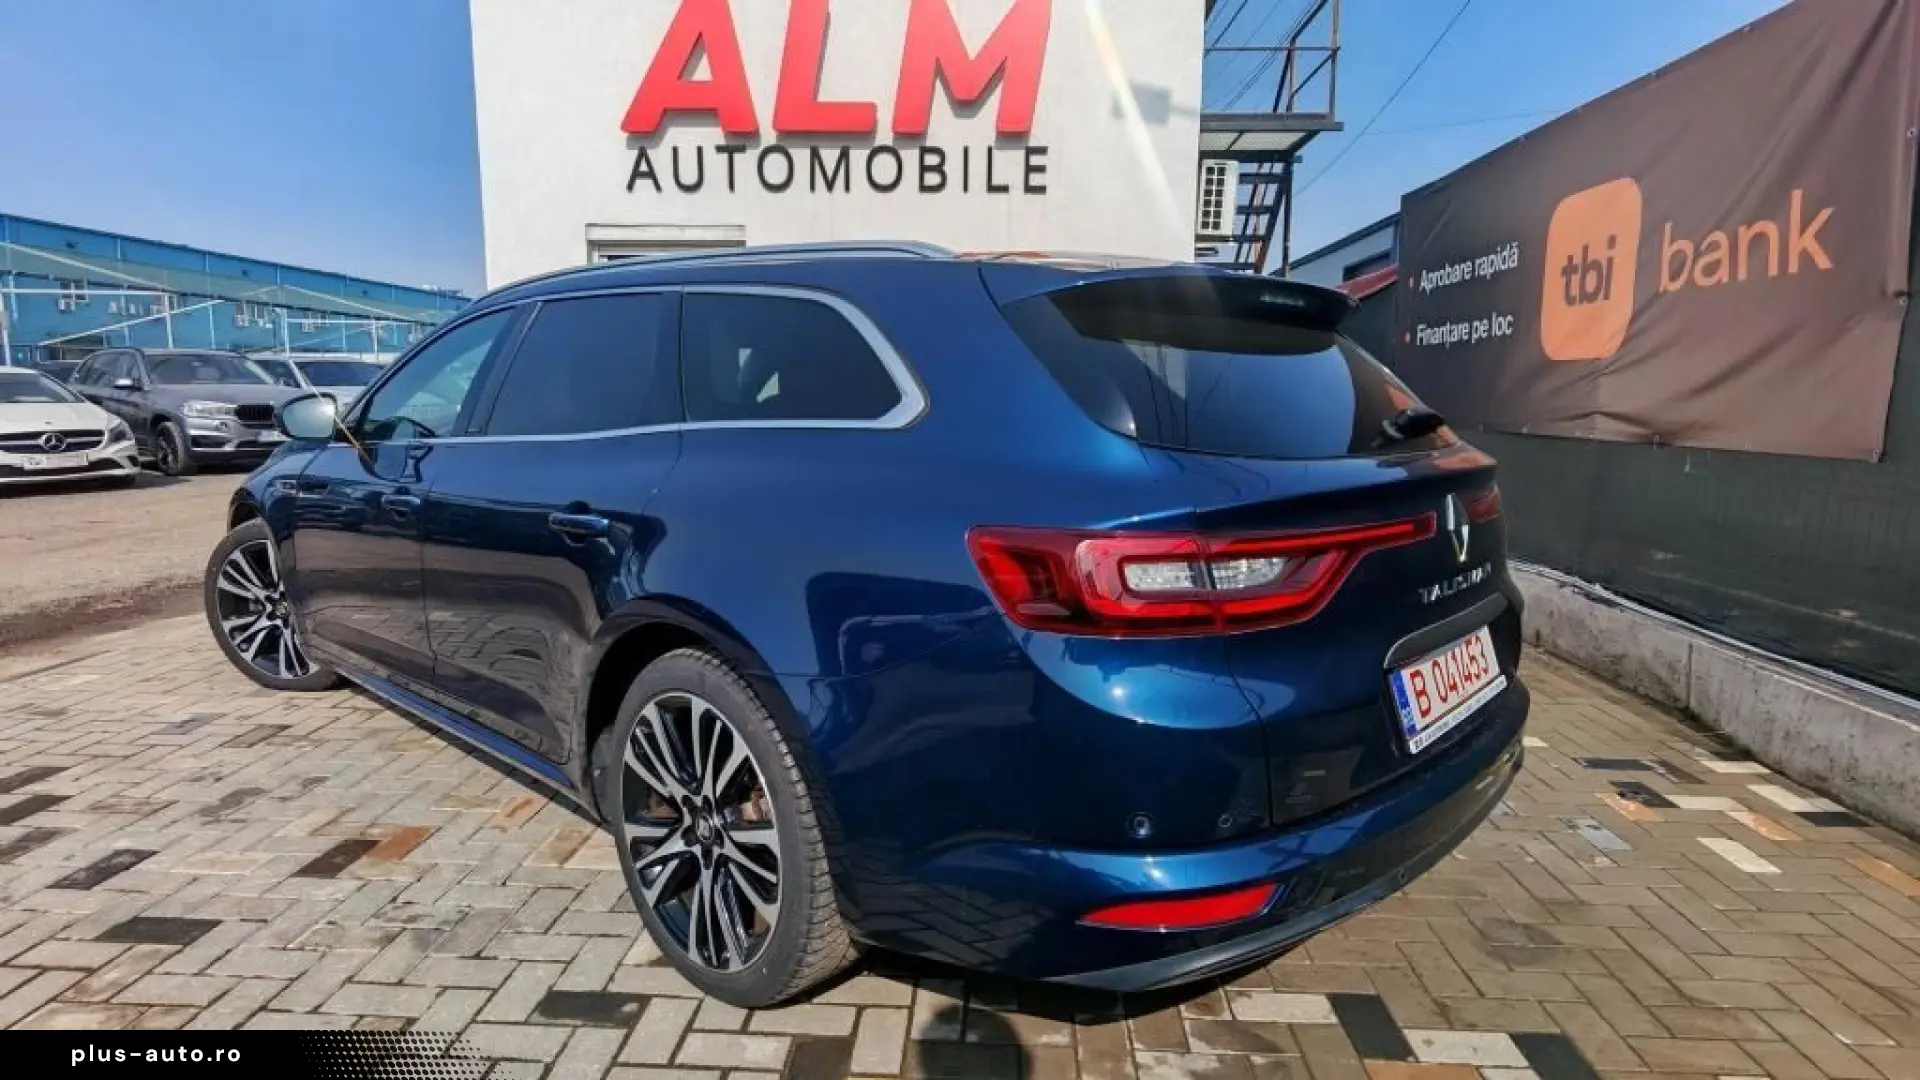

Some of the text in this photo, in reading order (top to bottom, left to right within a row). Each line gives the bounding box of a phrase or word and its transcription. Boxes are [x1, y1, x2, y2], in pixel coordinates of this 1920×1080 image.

[620, 0, 1052, 134] ALM
[626, 145, 1049, 195] AUTOMOBILE
[1418, 241, 1520, 295] Aprobare rapidă
[1561, 188, 1836, 306] tbi bank
[1472, 318, 1490, 344] pe
[1492, 312, 1514, 337] loc
[1410, 668, 1432, 719] B
